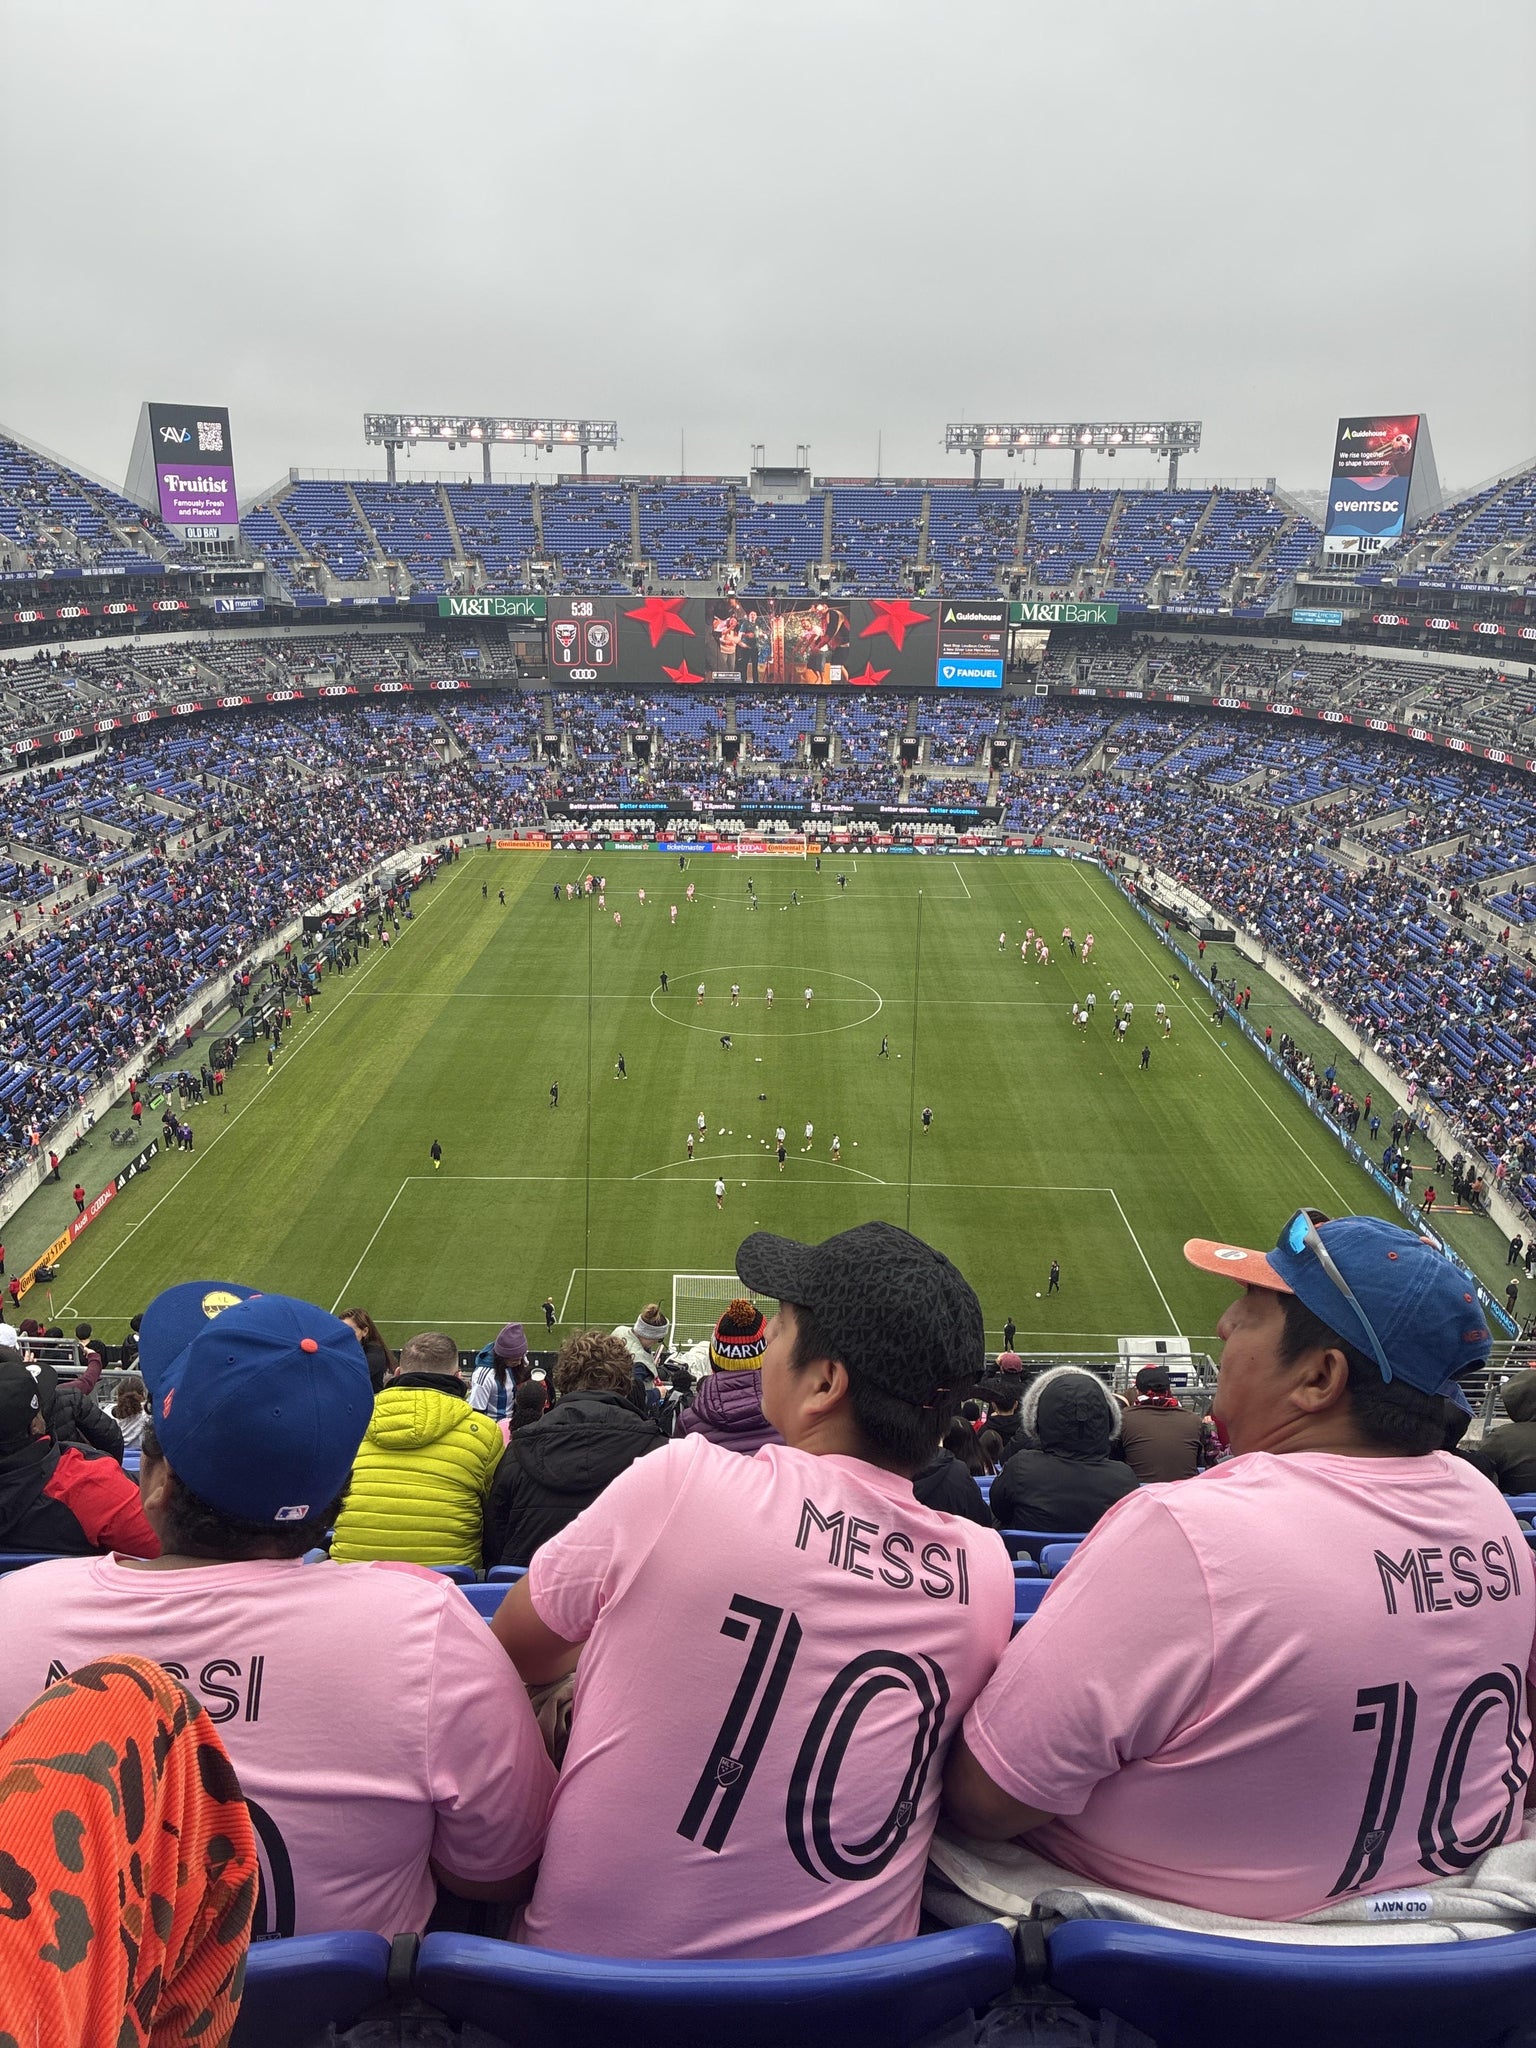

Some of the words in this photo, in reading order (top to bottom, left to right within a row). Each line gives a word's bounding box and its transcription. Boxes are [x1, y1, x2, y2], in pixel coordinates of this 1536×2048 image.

[1352, 430, 1387, 438] Guidehouse
[163, 474, 228, 493] Fruitist
[174, 499, 205, 507] Famously
[193, 508, 222, 516] Flavorful
[187, 528, 201, 538] OLD
[204, 528, 218, 538] BAY
[1358, 537, 1381, 552] Lite
[450, 599, 494, 615] M&T
[495, 599, 536, 616] Bank
[571, 602, 593, 616] 5:38
[1020, 603, 1065, 620] M&T
[1065, 604, 1107, 623] Bank
[956, 612, 1002, 621] Guidehouse
[564, 649, 570, 662] 0
[596, 649, 602, 662] 0
[956, 668, 998, 678] FANDUEL
[880, 805, 898, 813] Better
[899, 806, 929, 814] questions.
[498, 840, 531, 848] Continental
[536, 840, 550, 848] Tire
[666, 843, 705, 851] ticketmaster
[716, 843, 732, 851] Audi
[767, 843, 801, 852] Continental
[74, 1215, 88, 1234] Audi
[55, 1237, 67, 1255] Tire
[1491, 1301, 1516, 1333] MONARCH
[794, 1497, 970, 1605] MESSI
[1373, 1535, 1521, 1615] MESSI
[676, 1592, 951, 1884] 10
[1325, 1662, 1528, 1898] 10
[1374, 1902, 1403, 1912] NAVY
[1406, 1902, 1427, 1911] OLD
